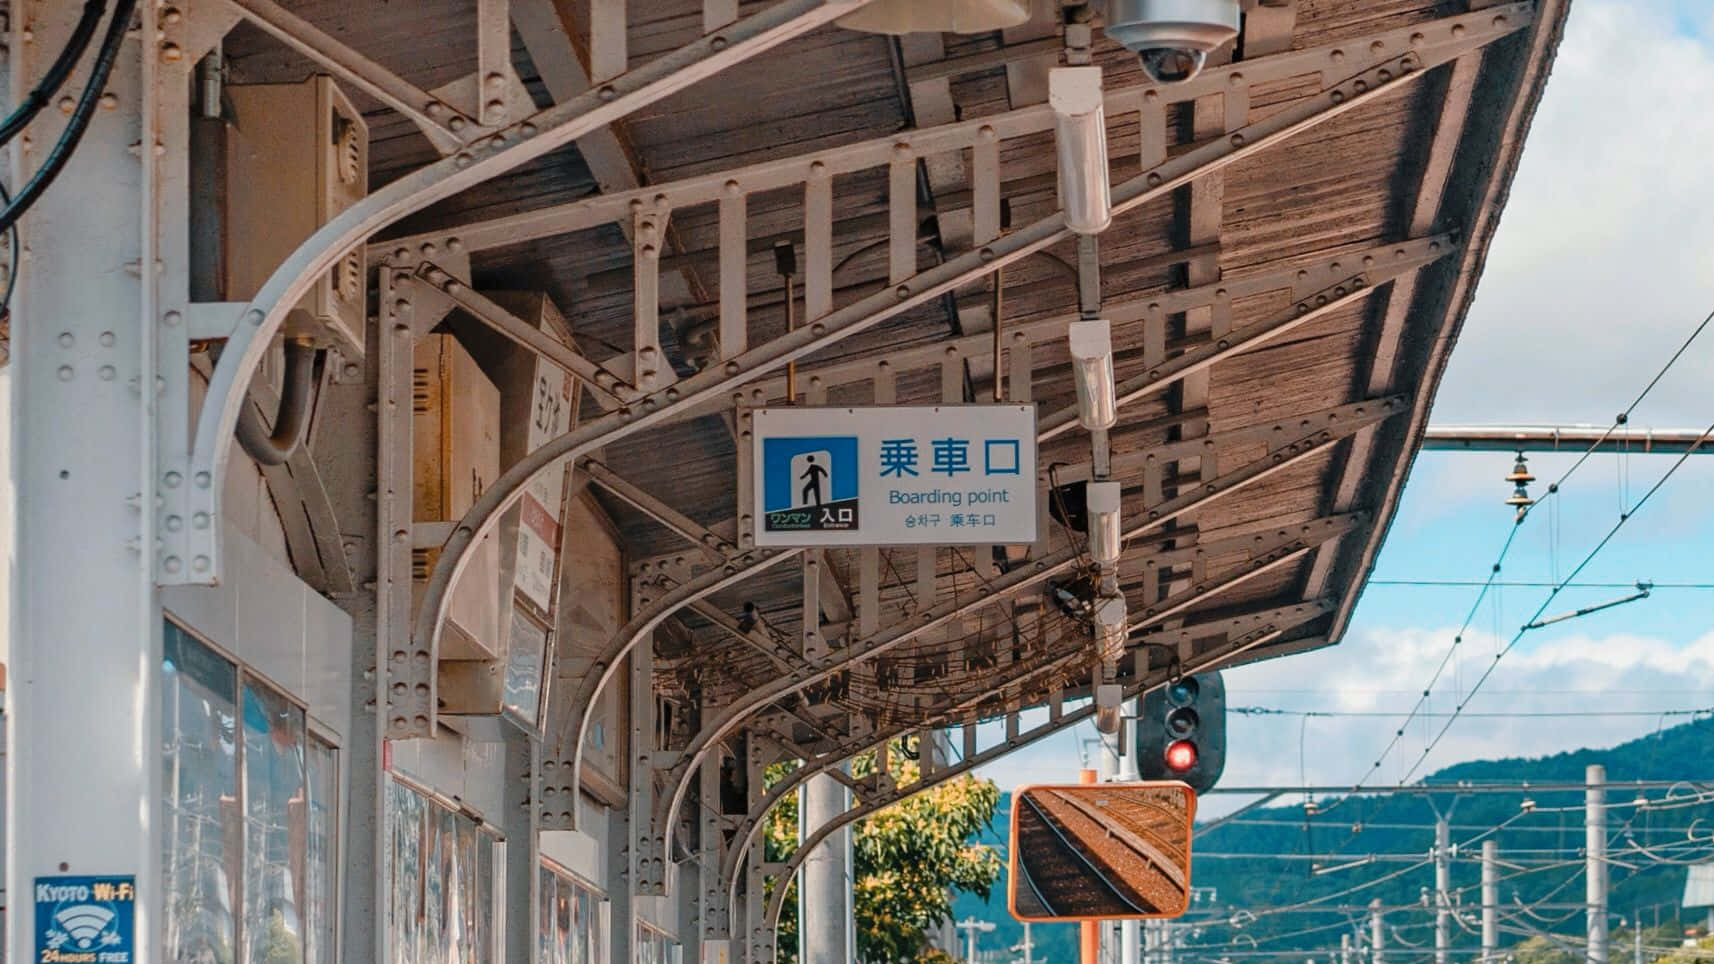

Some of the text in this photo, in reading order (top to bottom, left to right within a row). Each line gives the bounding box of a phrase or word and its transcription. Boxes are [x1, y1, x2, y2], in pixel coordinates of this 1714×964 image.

[879, 437, 1021, 478] 乗車口
[889, 488, 1009, 507] Boarding point
[771, 512, 812, 524] ワンマン
[820, 508, 853, 522] 入口
[92, 882, 134, 902] Wi-Fi
[98, 951, 129, 963] FREE
